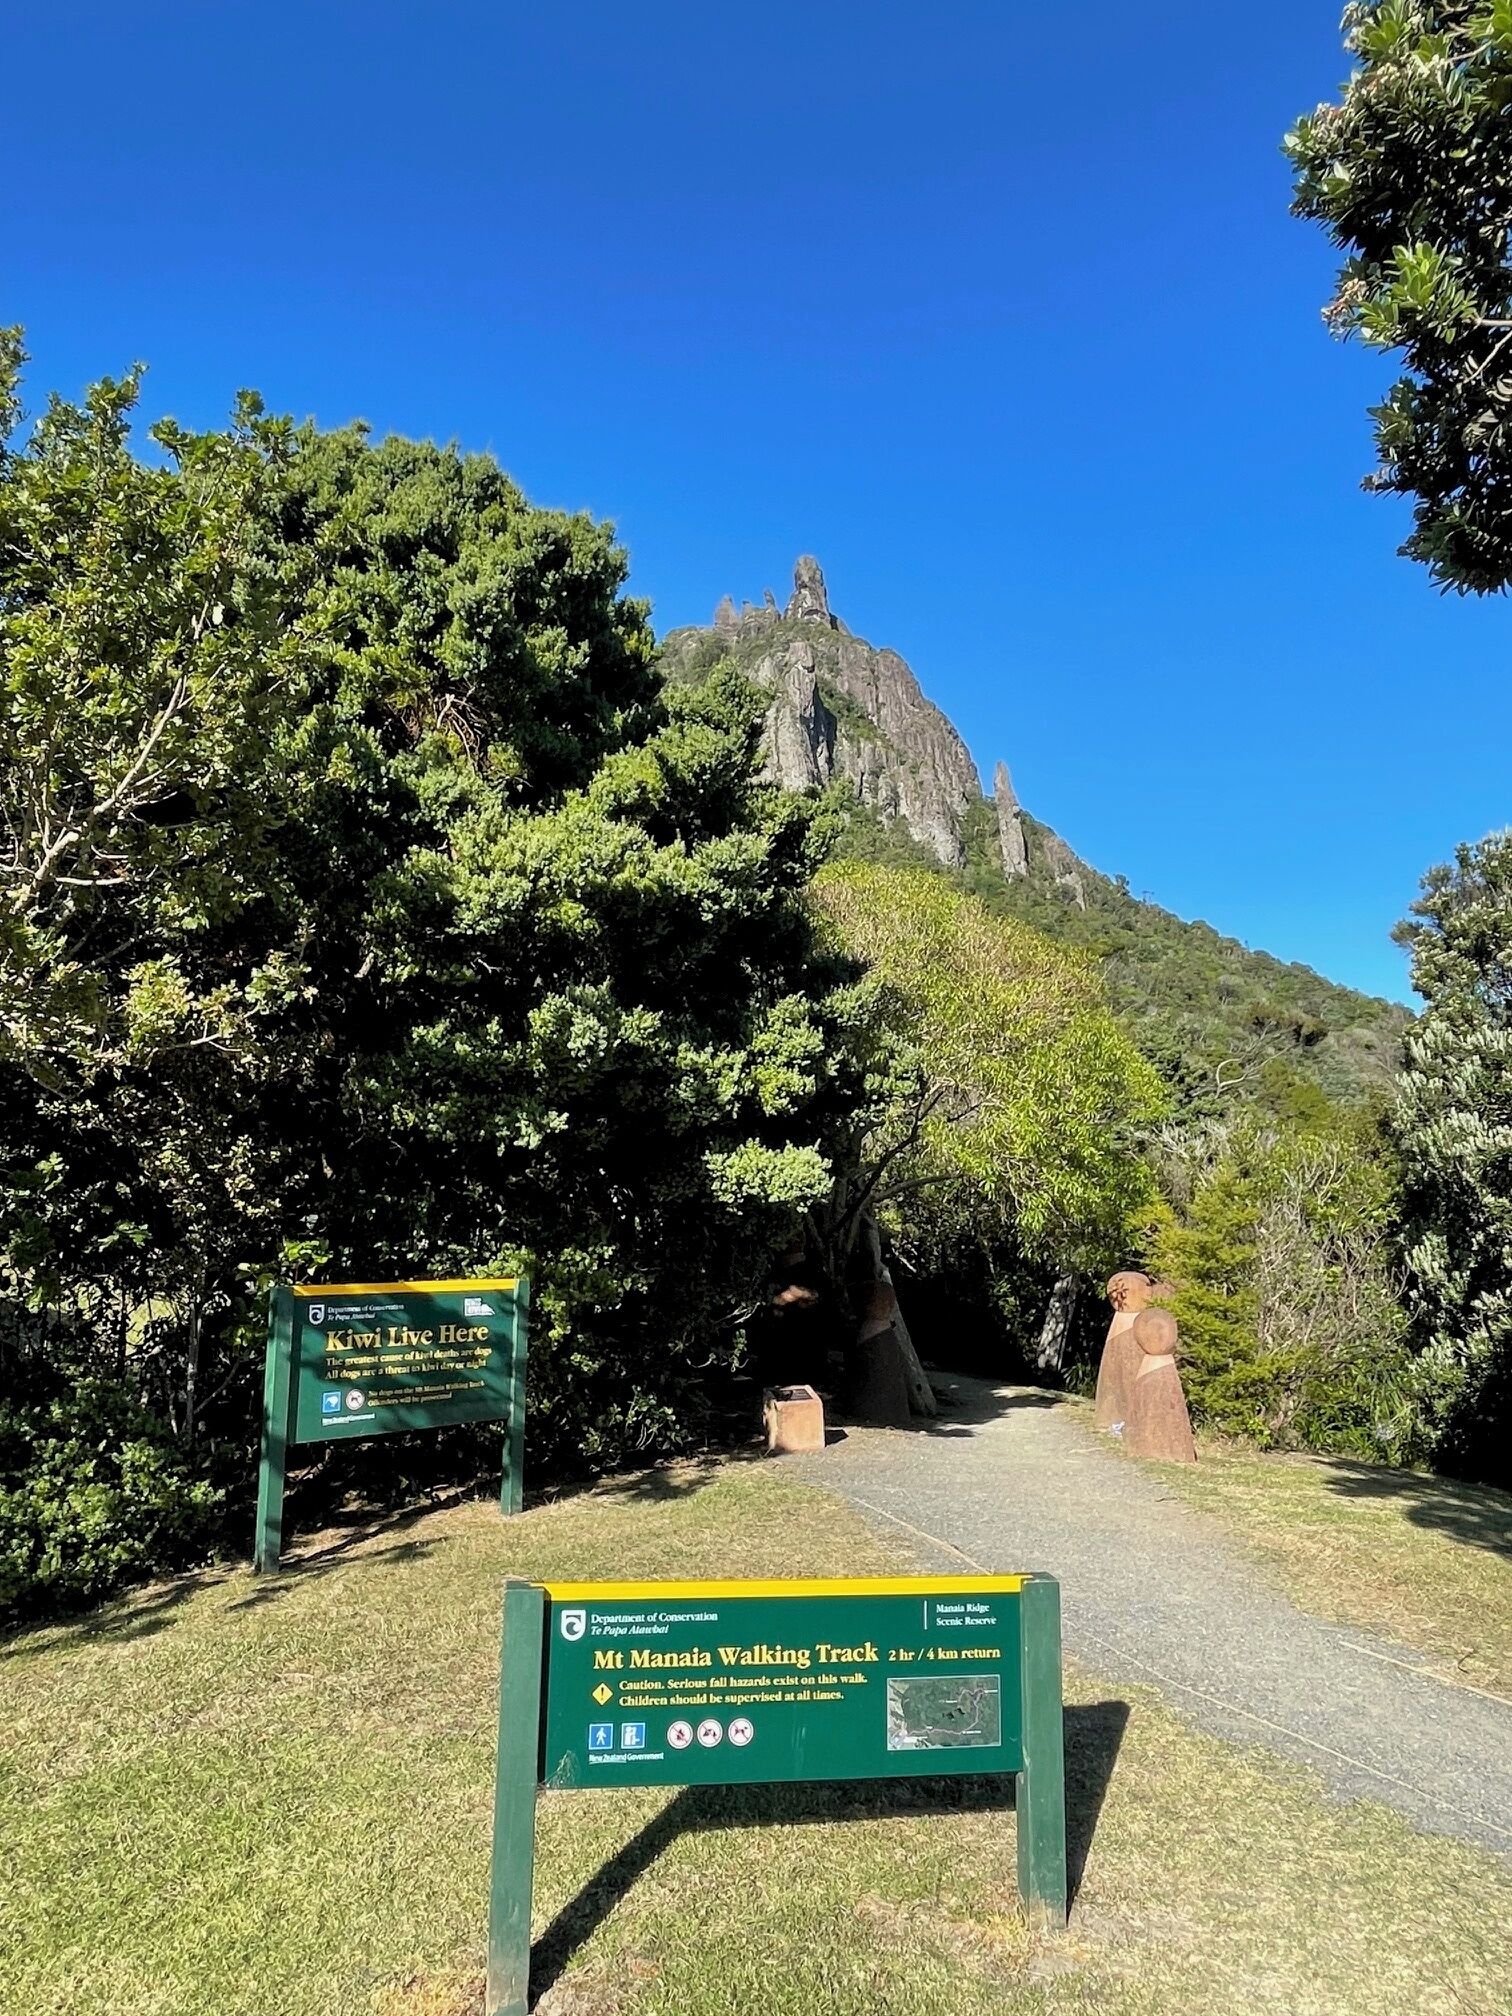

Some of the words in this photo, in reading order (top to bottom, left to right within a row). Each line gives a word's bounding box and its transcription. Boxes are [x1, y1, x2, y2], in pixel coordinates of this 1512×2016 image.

[327, 1306, 361, 1314] Department
[326, 1327, 382, 1351] Kiwi
[387, 1325, 433, 1347] Live
[439, 1324, 489, 1344] Here
[326, 1357, 344, 1367] The
[345, 1355, 378, 1366] greatest
[380, 1354, 403, 1363] cause
[404, 1351, 415, 1361] of
[415, 1350, 433, 1360] kiwi
[434, 1348, 460, 1359] deaths
[474, 1346, 492, 1357] dogs
[325, 1369, 338, 1380] All
[340, 1368, 361, 1380] dogs
[362, 1368, 375, 1377] are
[385, 1365, 410, 1375] threat
[422, 1362, 440, 1372] kiwi
[440, 1362, 455, 1371] day
[455, 1361, 465, 1370] or
[466, 1359, 486, 1370] night
[936, 1604, 965, 1613] Manaia
[966, 1603, 990, 1613] Ridge
[591, 1614, 645, 1625] Department
[647, 1612, 657, 1622] of
[658, 1612, 718, 1621] Conservation
[936, 1617, 963, 1626] Scenic
[964, 1616, 997, 1625] Reserve
[591, 1626, 602, 1635] Te
[602, 1625, 627, 1637] Papa
[628, 1624, 669, 1635] Atawhai
[593, 1650, 624, 1669] Mt
[629, 1646, 712, 1668] Manaia
[717, 1644, 811, 1669] Walking
[815, 1641, 879, 1663] Track
[888, 1649, 897, 1661] 2
[899, 1648, 915, 1661] hr
[917, 1648, 924, 1661] /
[926, 1647, 935, 1660] 4
[937, 1647, 958, 1659] km
[961, 1648, 1001, 1659] return
[619, 1680, 665, 1690] Caution.
[667, 1678, 707, 1689] Serious
[709, 1677, 727, 1688] fall
[729, 1675, 771, 1687] hazards
[772, 1674, 799, 1686] exist
[801, 1676, 816, 1685] on
[817, 1673, 838, 1684] this
[840, 1673, 868, 1684] walk.
[619, 1695, 668, 1706] Children
[669, 1693, 707, 1705] should
[709, 1693, 723, 1704] be
[724, 1690, 782, 1705] supervised
[784, 1691, 796, 1701] at
[796, 1690, 811, 1701] all
[813, 1689, 844, 1700] times.
[589, 1754, 603, 1762] New
[603, 1753, 627, 1762] Zealand
[627, 1752, 664, 1761] Government
